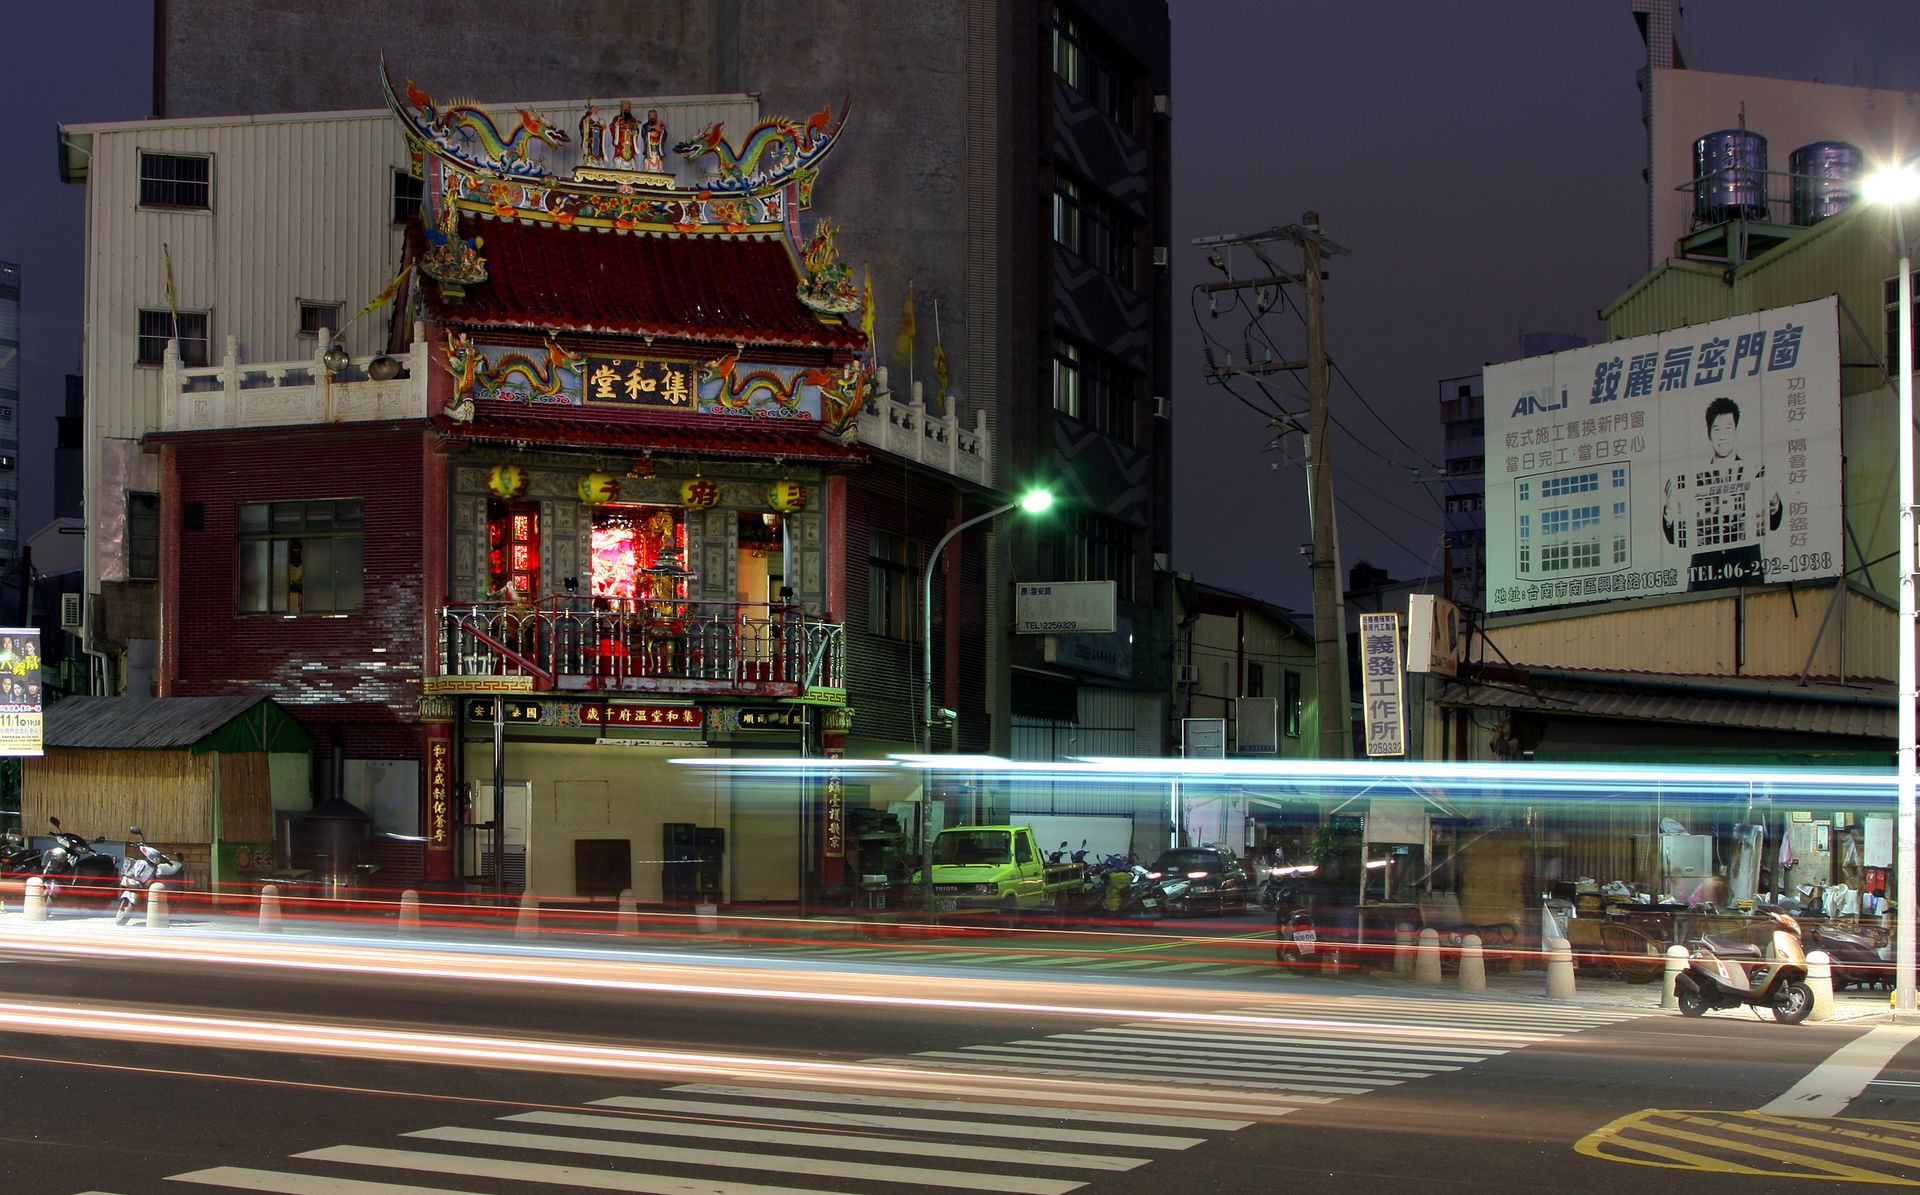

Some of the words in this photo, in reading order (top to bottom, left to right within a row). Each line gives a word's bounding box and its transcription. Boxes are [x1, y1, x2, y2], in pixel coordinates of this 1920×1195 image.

[590, 364, 688, 404] 集和堂
[1504, 410, 1646, 449] 乾式施工舊換新門窗
[1687, 551, 1832, 583] TEL:06-292-1938
[1366, 634, 1398, 741] 義發工作所
